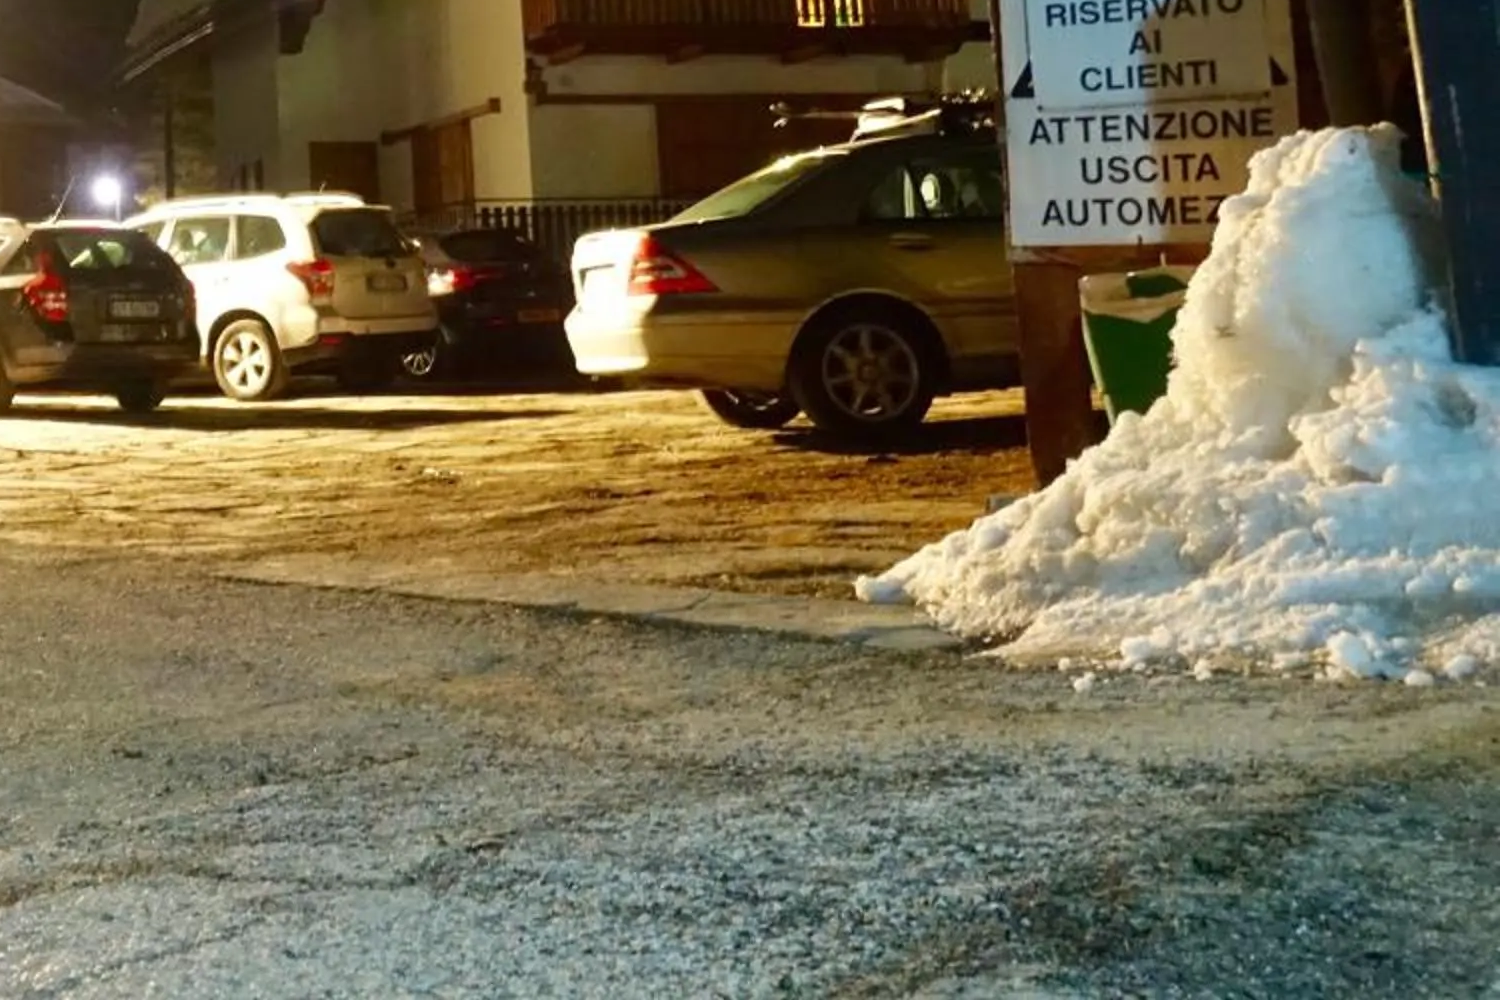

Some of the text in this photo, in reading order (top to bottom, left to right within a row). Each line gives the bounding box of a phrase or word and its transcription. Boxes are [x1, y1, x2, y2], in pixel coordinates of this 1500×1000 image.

[1127, 29, 1162, 55] AI
[1079, 58, 1219, 92] CLIENTI
[1028, 106, 1275, 146] ATTENZIONE
[1079, 153, 1221, 185] USCITA
